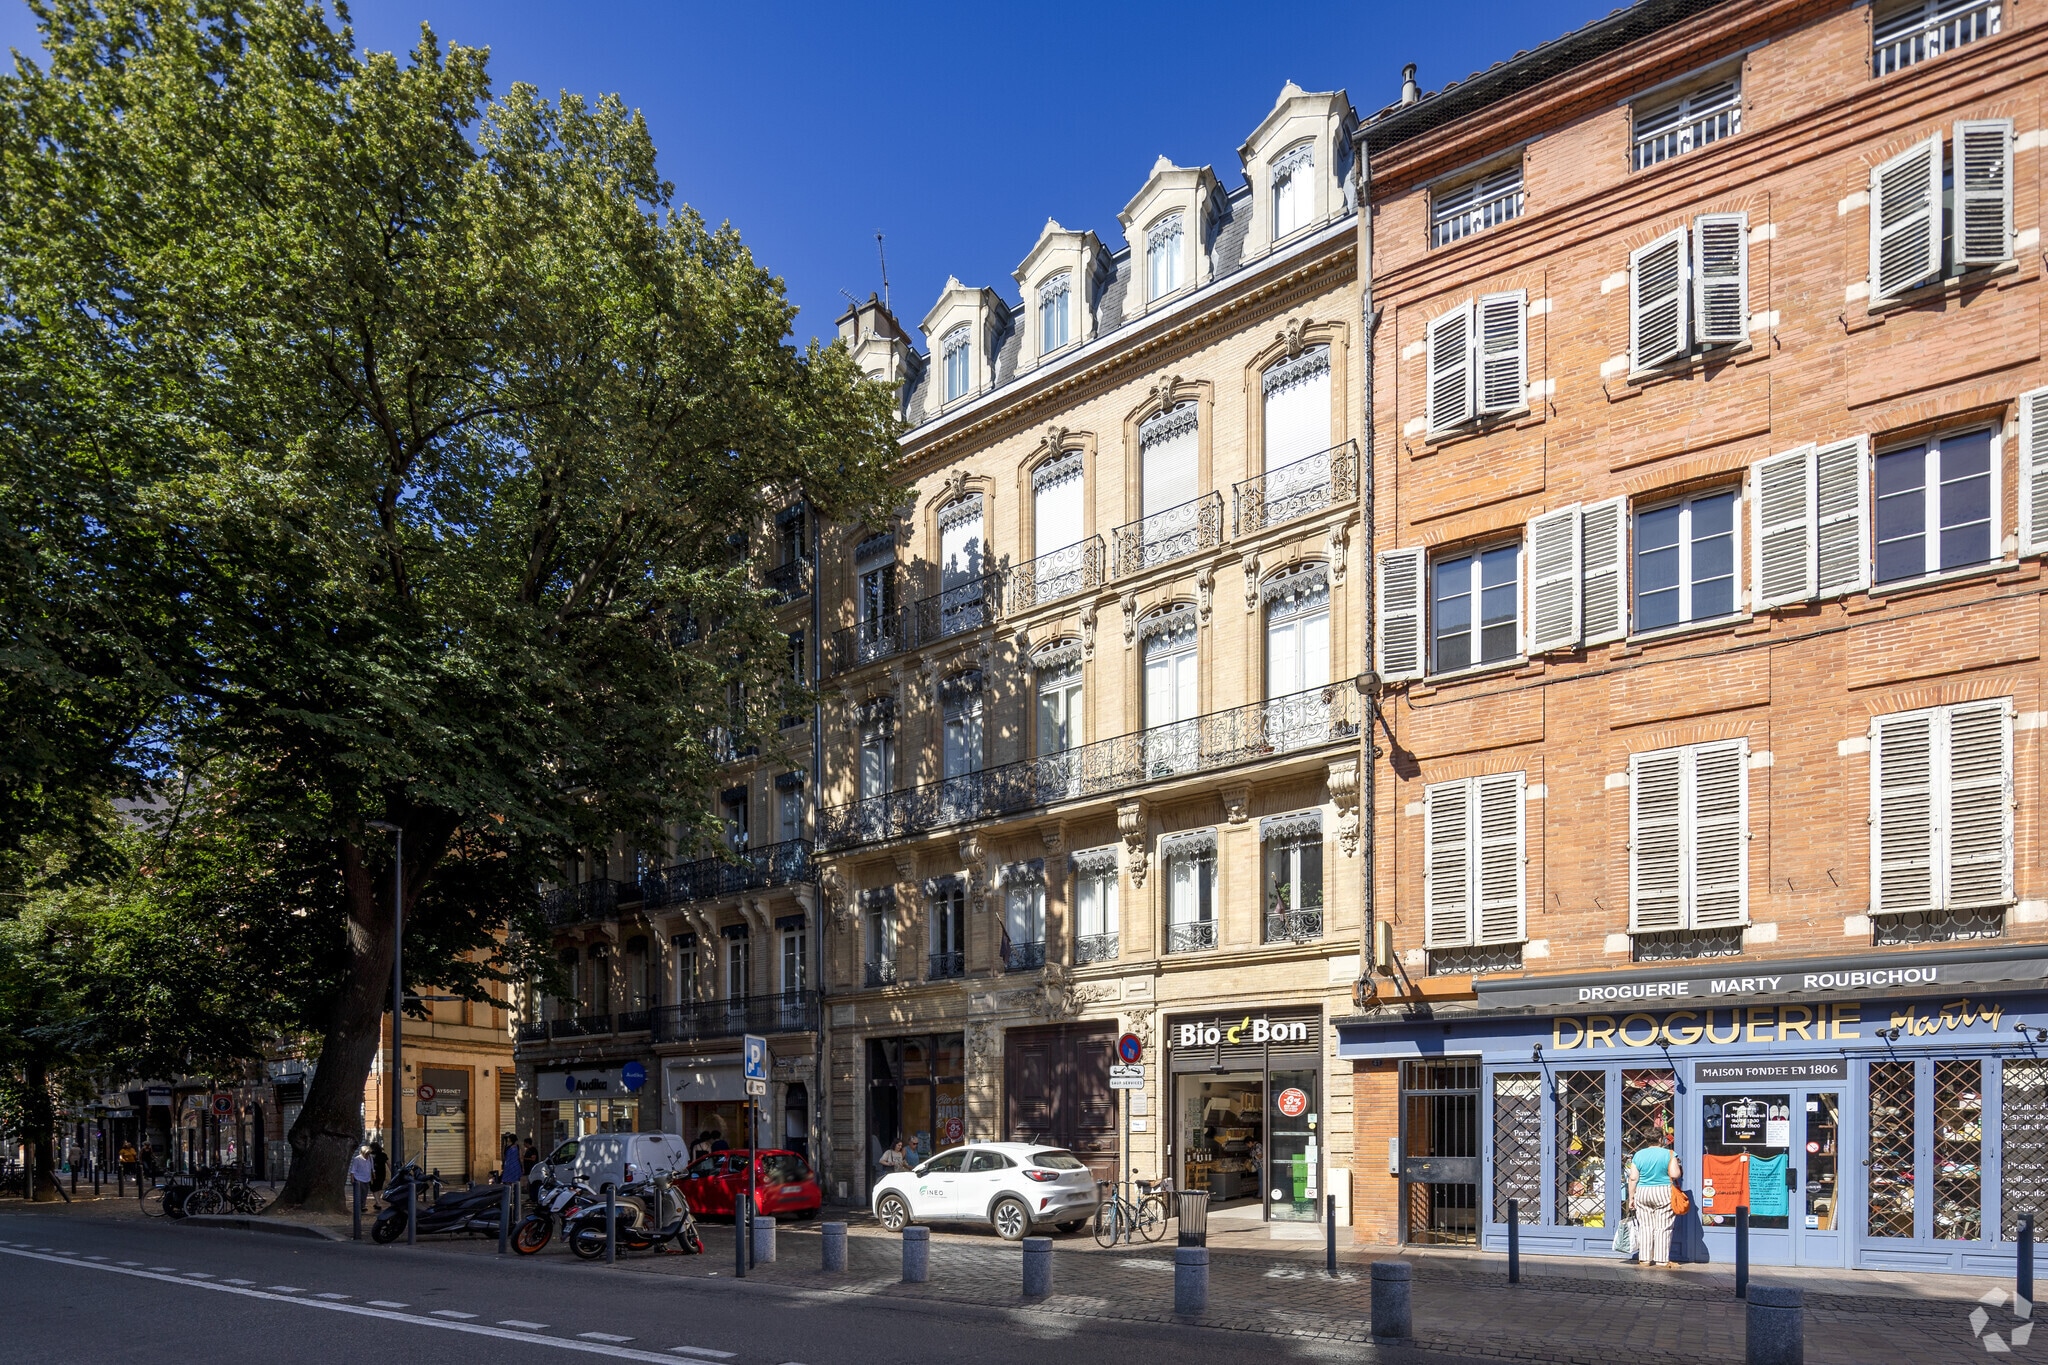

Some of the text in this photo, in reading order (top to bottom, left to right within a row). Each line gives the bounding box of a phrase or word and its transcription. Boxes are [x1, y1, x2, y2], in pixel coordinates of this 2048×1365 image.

[1579, 967, 1937, 1000] DROGUERIE MARTY ROUBICHOU
[1180, 1021, 1221, 1047] Bio
[1253, 1018, 1307, 1042] Bon
[1553, 1002, 1861, 1050] DROGUERIE
[1890, 998, 2005, 1038] Marty
[751, 1044, 760, 1064] P
[576, 1077, 608, 1091] Audika
[1702, 1064, 1838, 1077] MAISON FONDEE EN 1806
